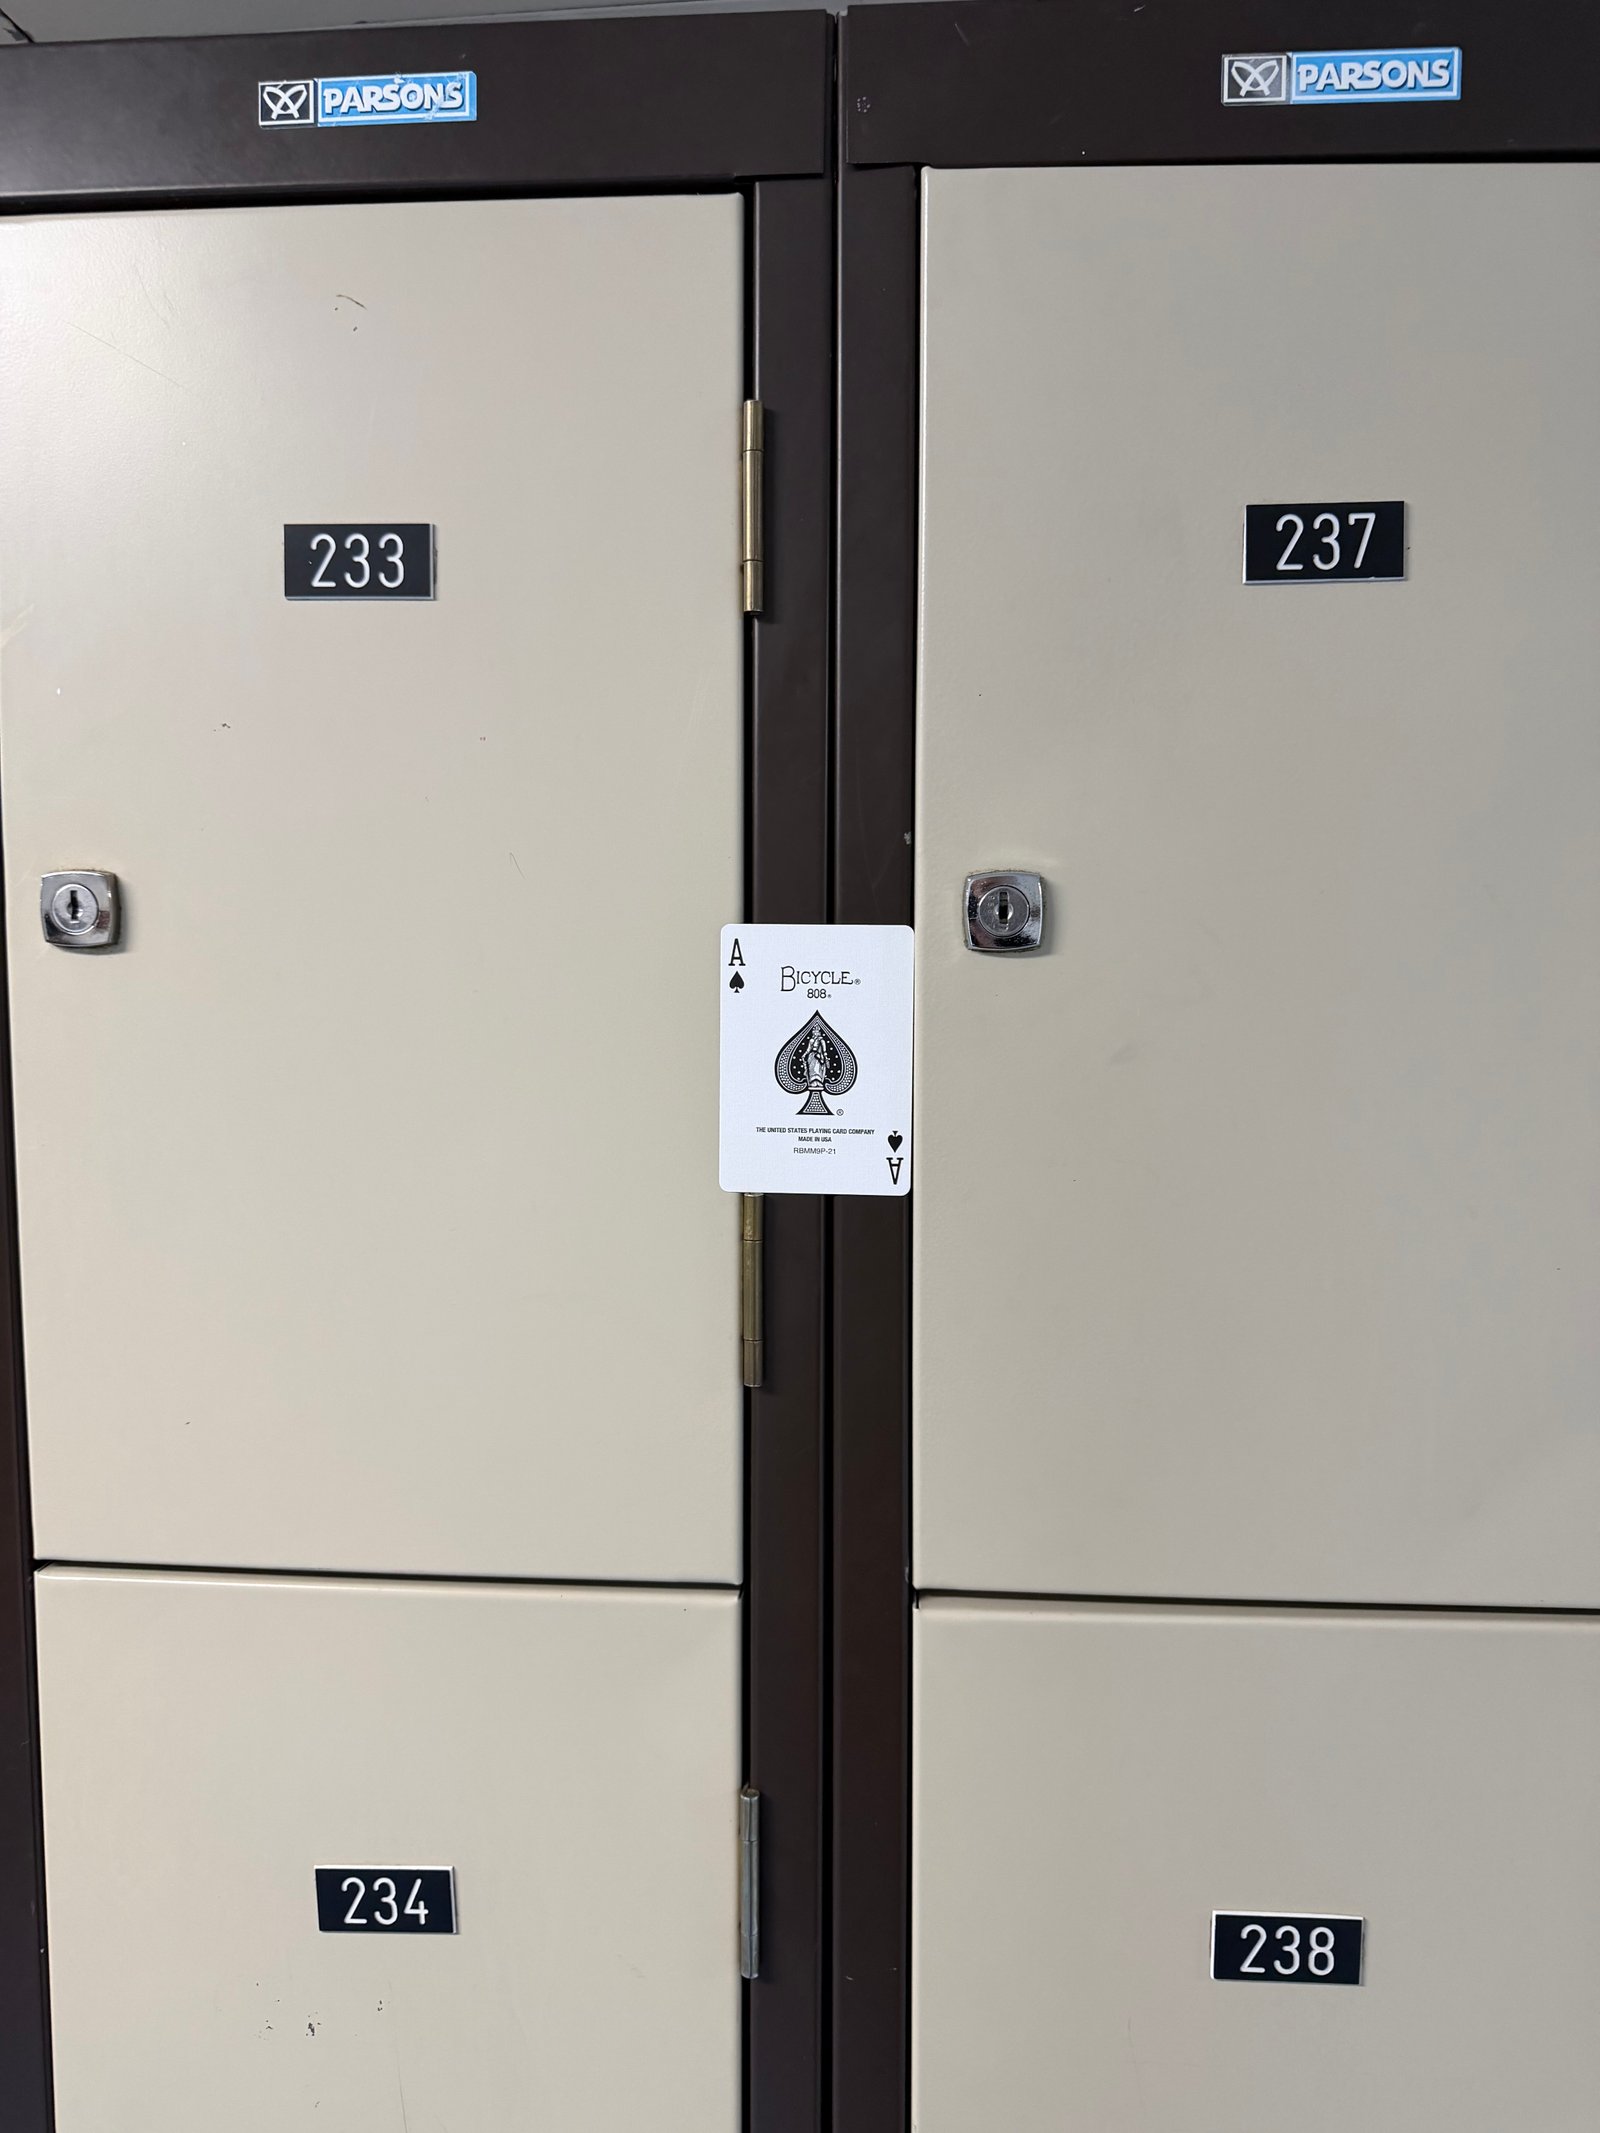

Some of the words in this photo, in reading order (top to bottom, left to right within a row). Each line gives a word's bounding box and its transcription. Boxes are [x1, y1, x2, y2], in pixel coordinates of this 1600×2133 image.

[1297, 59, 1450, 92] PARSONS
[323, 82, 464, 114] PARSONS
[1275, 512, 1377, 571] 237
[310, 532, 405, 588] 233
[728, 938, 746, 966] A
[806, 988, 827, 999] 808
[886, 1156, 904, 1185] A
[341, 1877, 429, 1925] 234
[1240, 1924, 1335, 1976] 238
